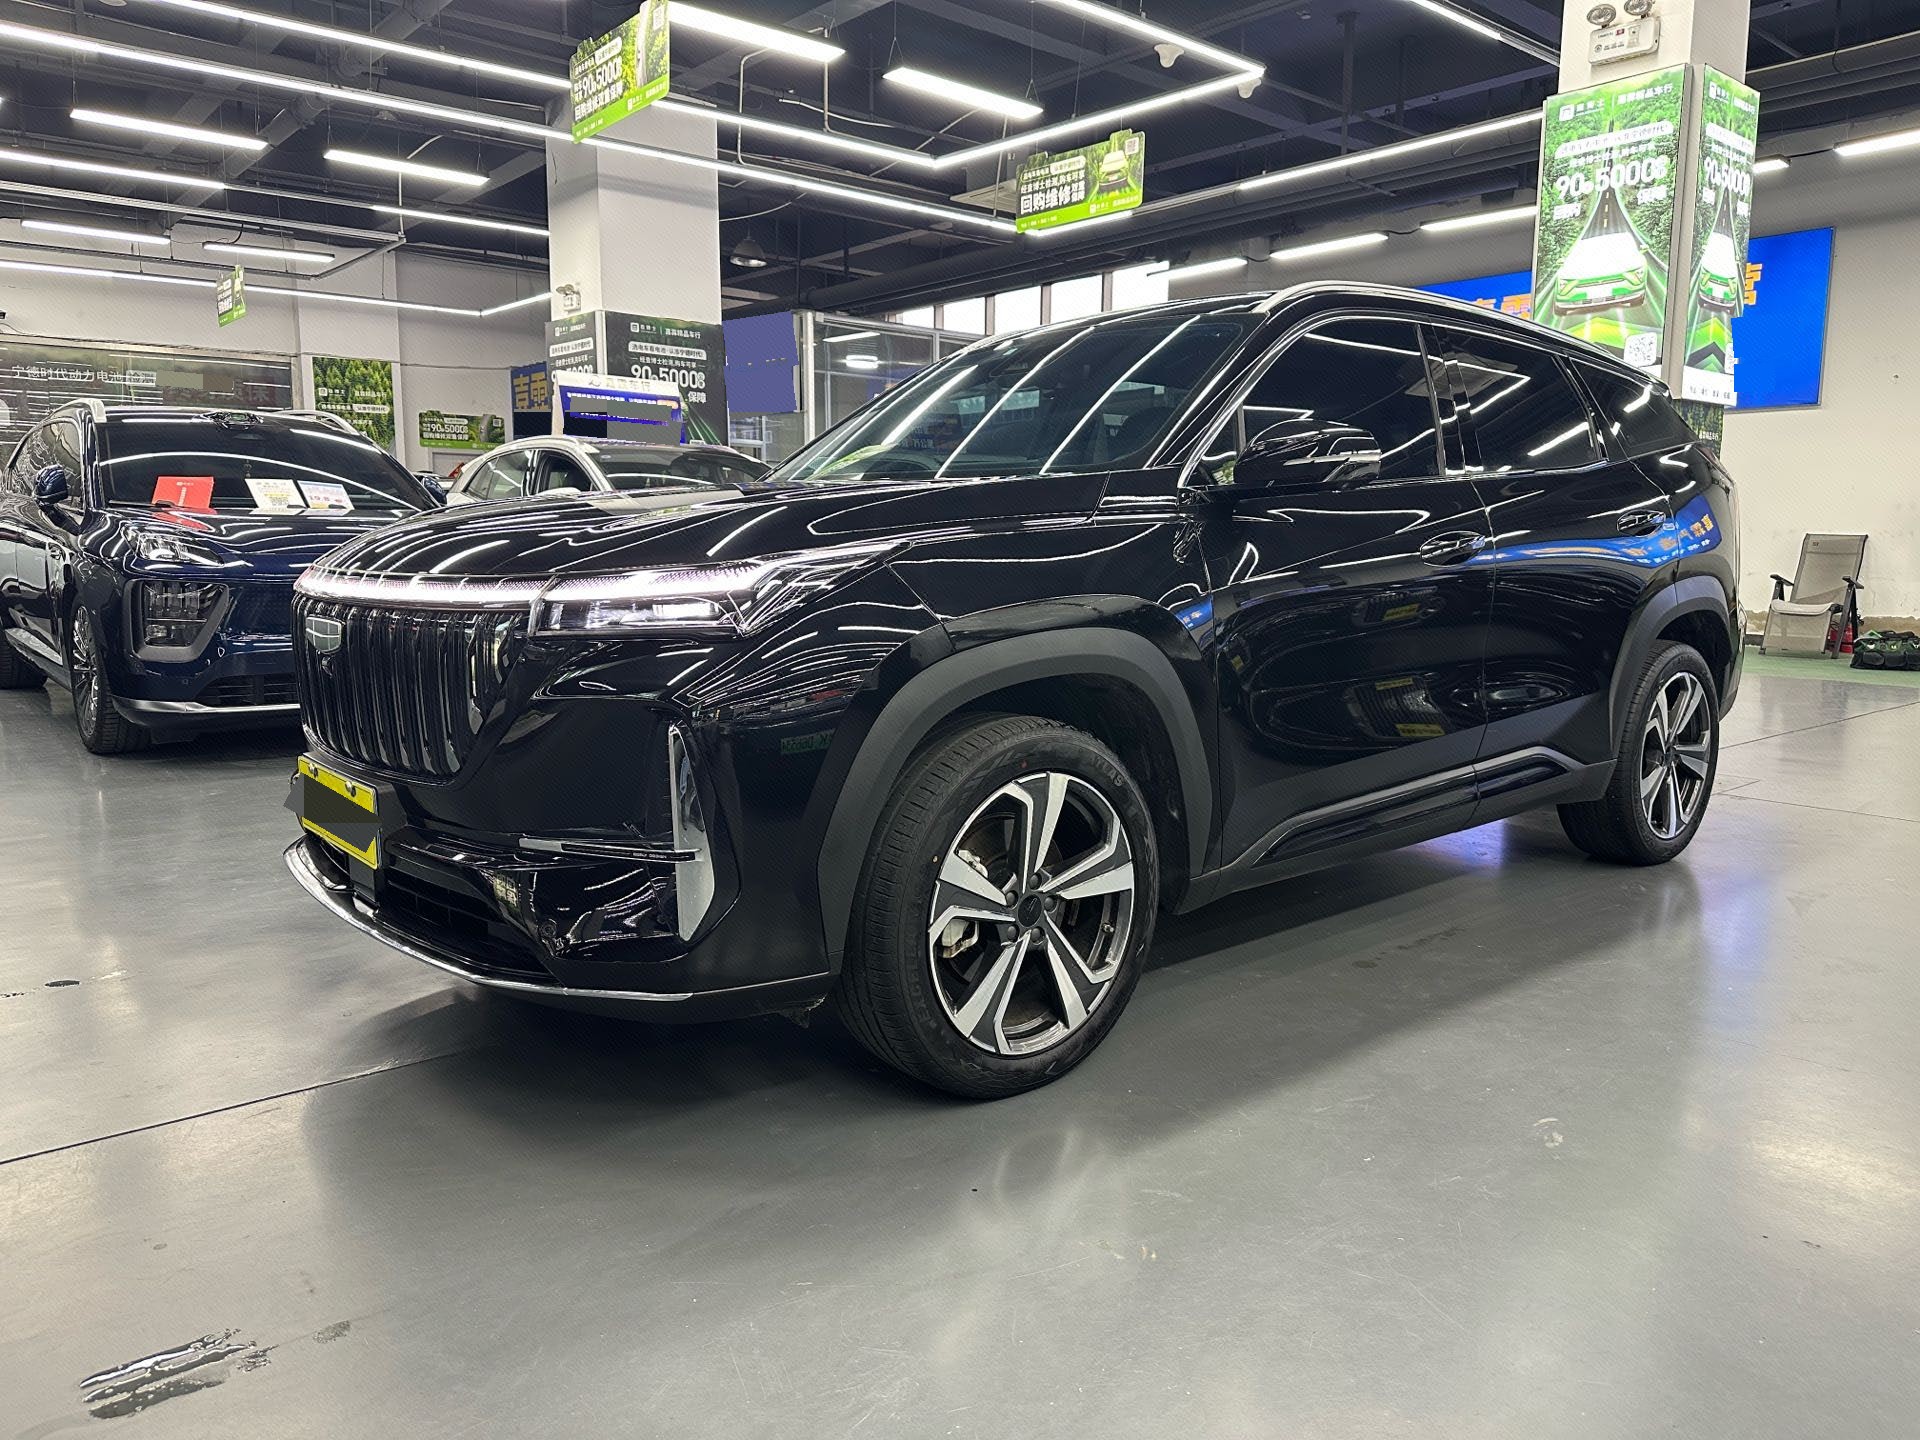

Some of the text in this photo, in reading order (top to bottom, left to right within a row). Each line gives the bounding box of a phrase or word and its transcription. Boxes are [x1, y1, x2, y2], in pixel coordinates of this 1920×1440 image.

[1020, 185, 1071, 215] 回购维修
[687, 391, 707, 404] 保障
